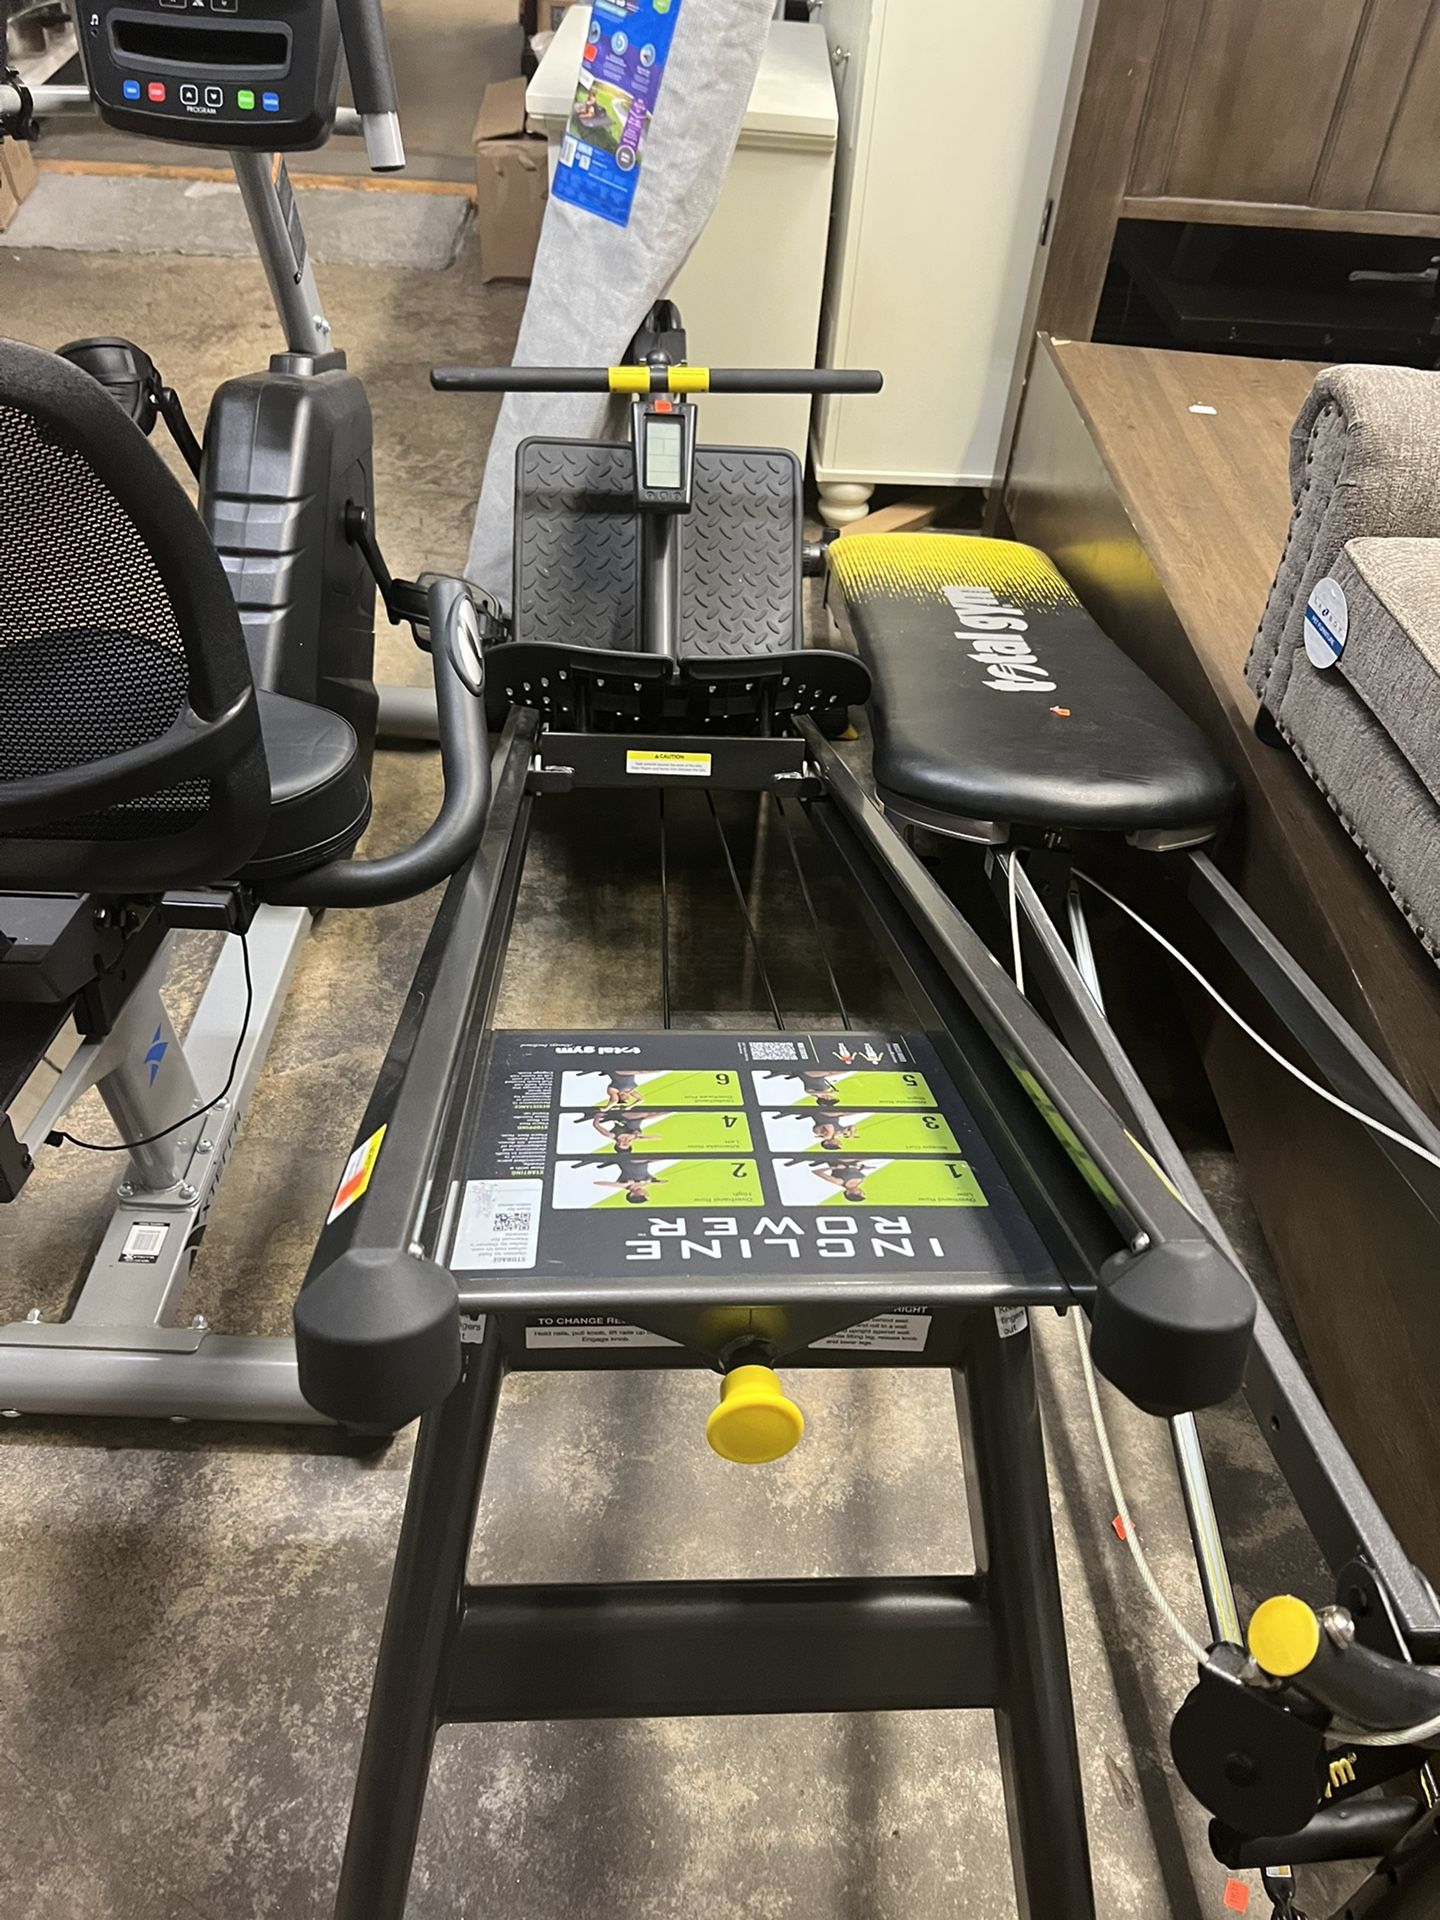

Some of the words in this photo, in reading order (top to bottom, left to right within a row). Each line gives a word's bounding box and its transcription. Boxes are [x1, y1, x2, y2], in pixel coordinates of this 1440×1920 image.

[186, 106, 216, 114] PROGRAM
[555, 1046, 596, 1054] gym
[715, 1073, 730, 1086] 6
[902, 1074, 918, 1086] 5
[722, 1115, 738, 1128] 4
[922, 1116, 940, 1130] 3
[730, 1162, 748, 1178] 2
[944, 1164, 962, 1178] 1
[625, 1238, 944, 1260] INCLINE
[556, 1317, 604, 1325] CHANGE
[582, 1336, 609, 1344] Engage
